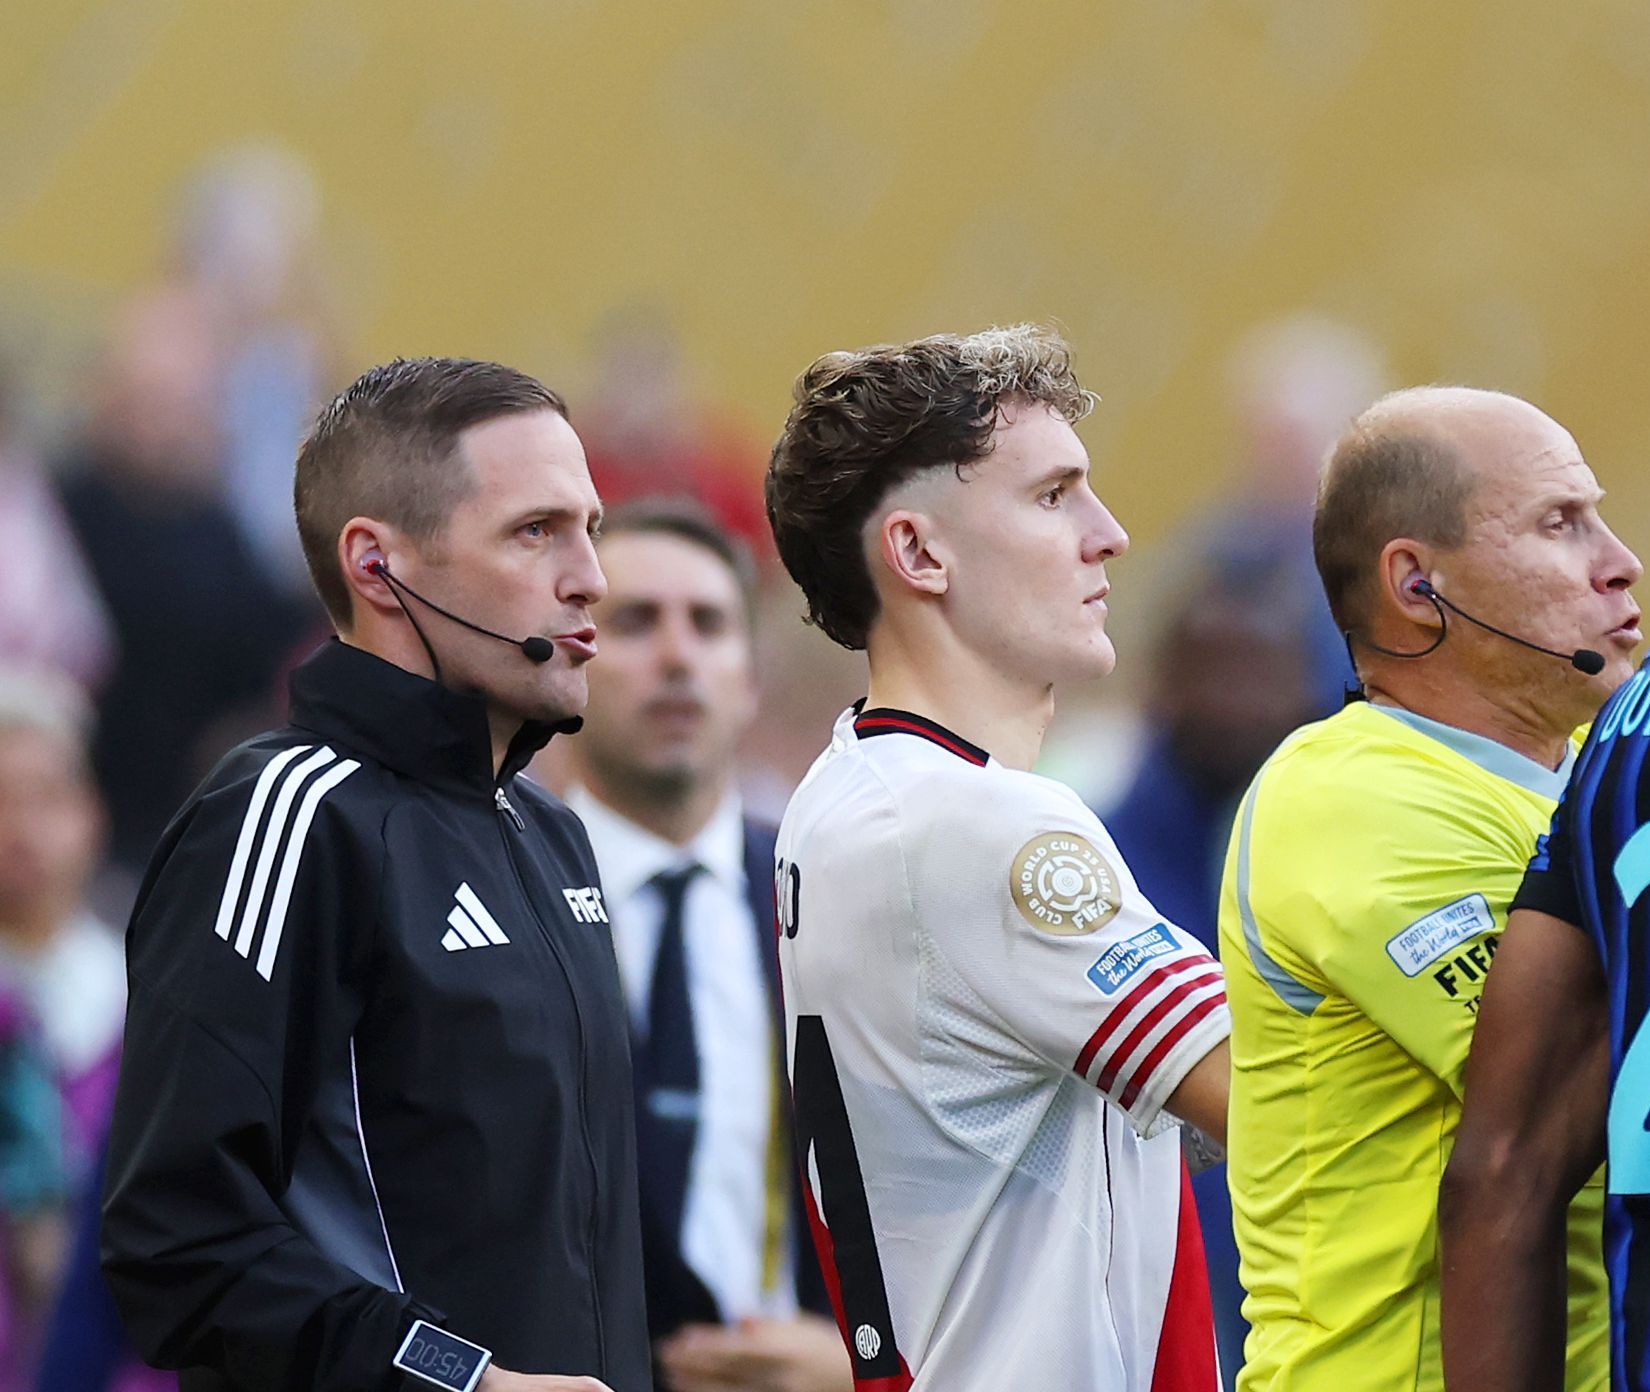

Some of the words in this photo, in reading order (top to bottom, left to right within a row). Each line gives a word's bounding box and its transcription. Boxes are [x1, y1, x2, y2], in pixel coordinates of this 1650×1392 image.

[1050, 840, 1080, 853] CUP
[1021, 846, 1048, 896] WORLD
[1028, 897, 1064, 925] CLUB
[1071, 898, 1113, 930] FIFA
[406, 1338, 468, 1380] 45:00
